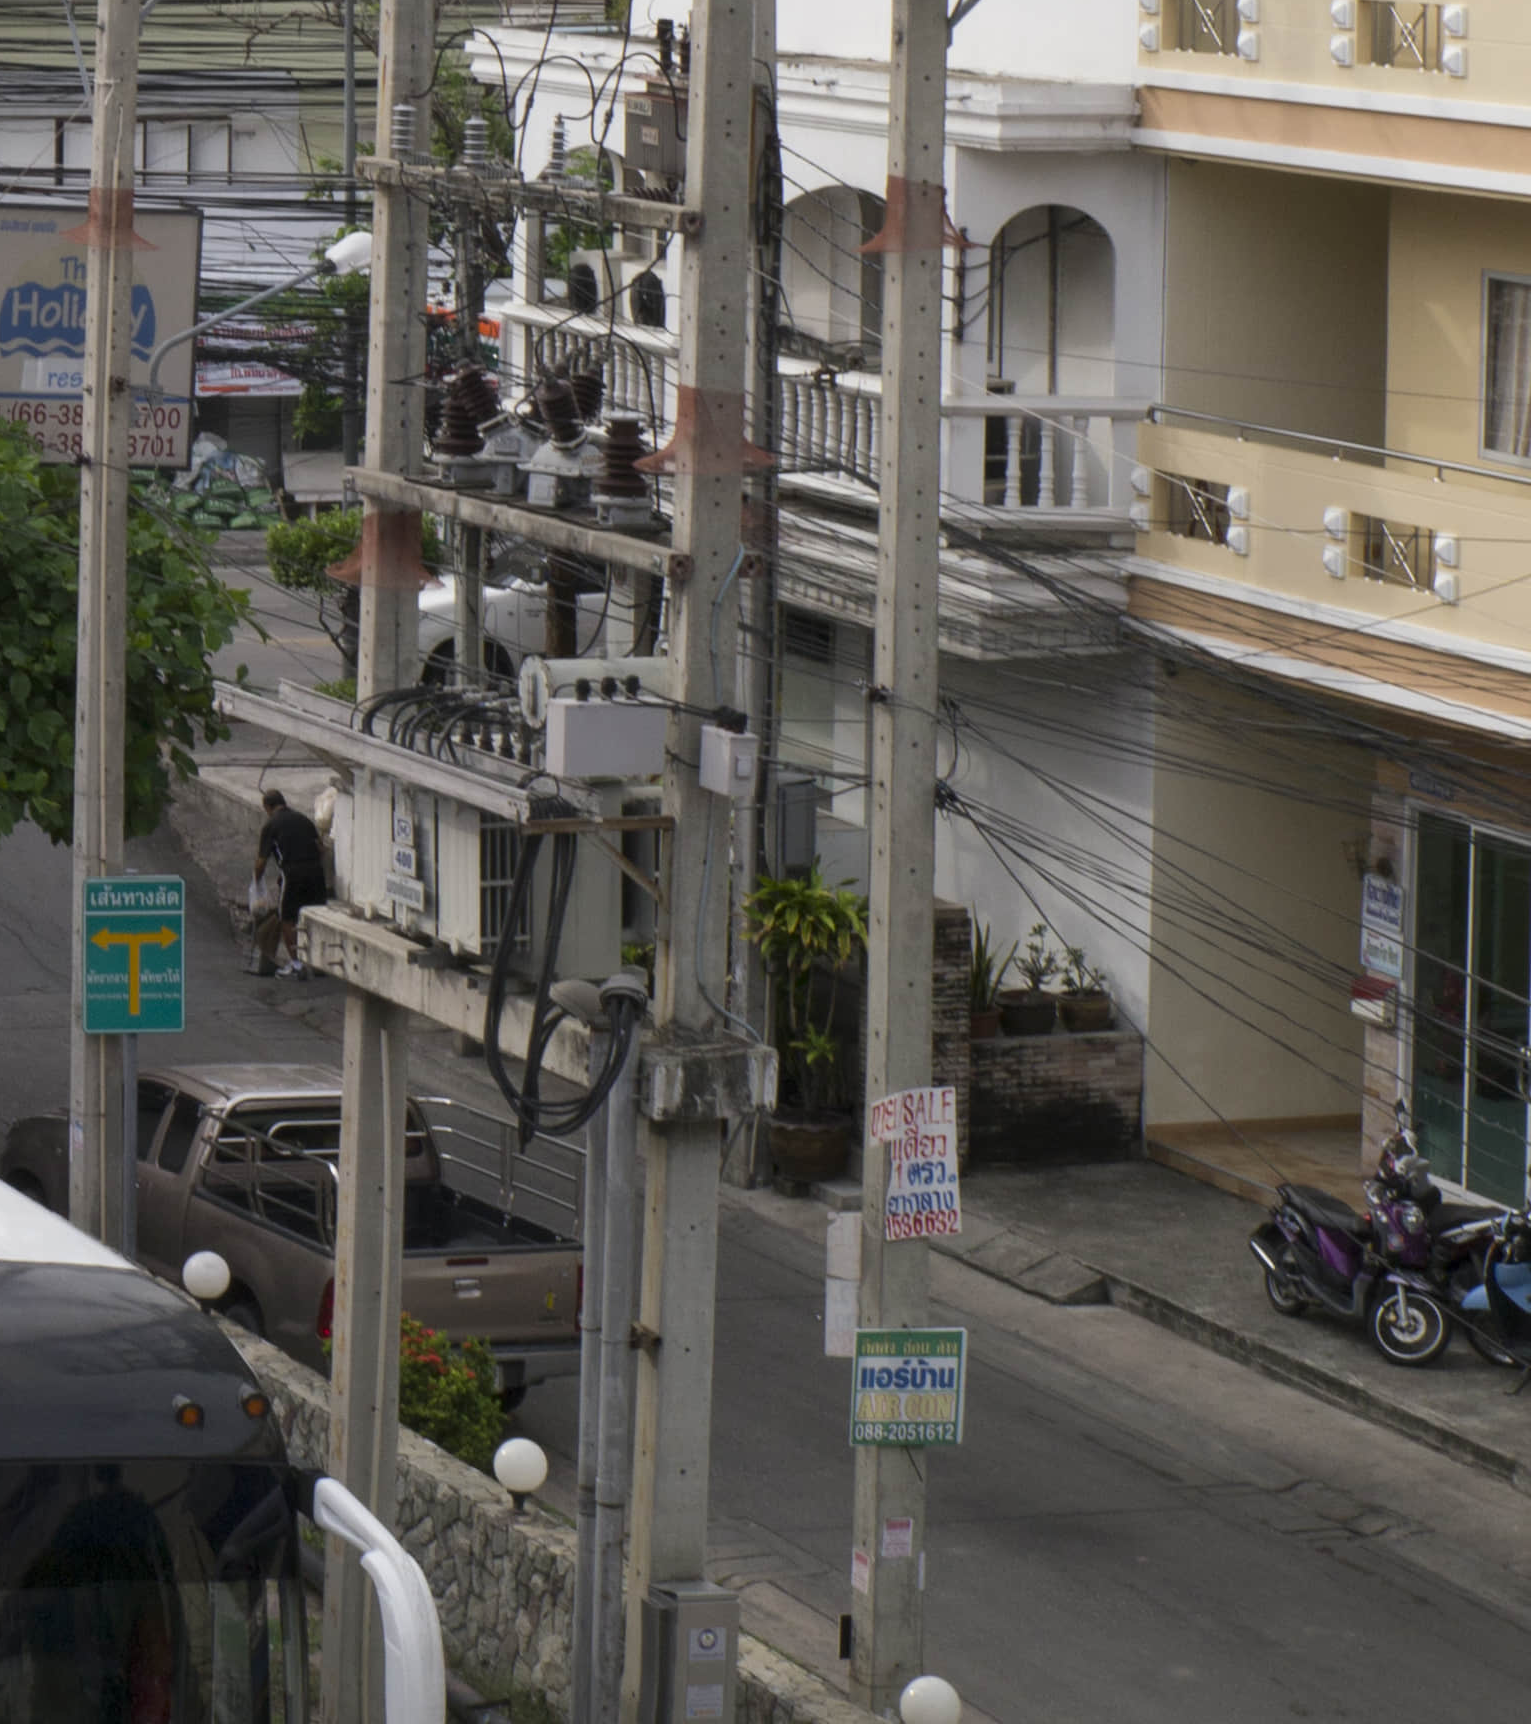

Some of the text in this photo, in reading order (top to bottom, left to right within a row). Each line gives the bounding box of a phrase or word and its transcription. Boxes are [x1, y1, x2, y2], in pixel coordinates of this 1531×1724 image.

[60, 255, 87, 281] Th
[11, 289, 147, 340] Holiy
[90, 884, 180, 907] เส้นทางลัด
[860, 1358, 956, 1389] แอร์บ้าน
[856, 1392, 956, 1422] AIR CON
[854, 1422, 956, 1442] 088-2051612
